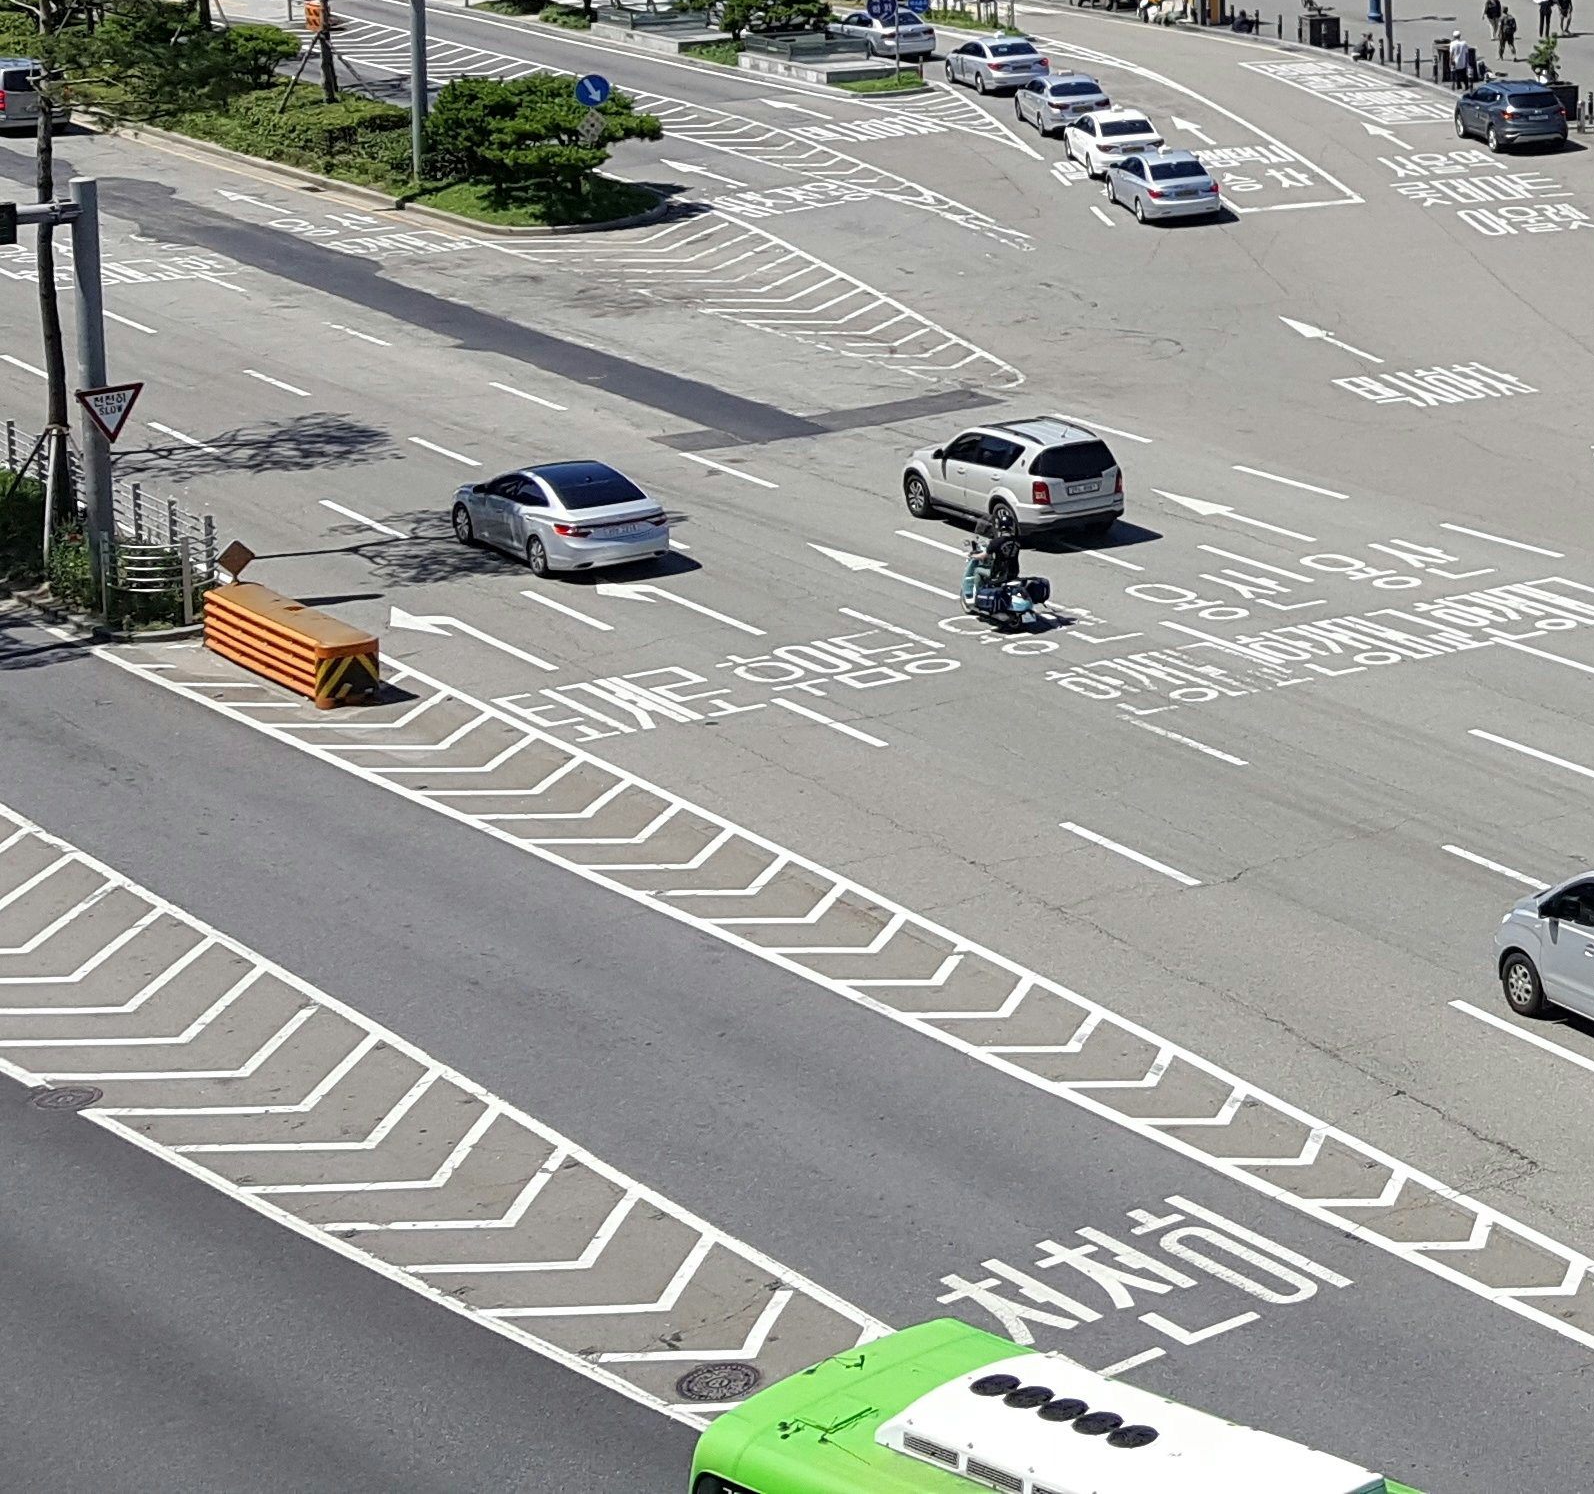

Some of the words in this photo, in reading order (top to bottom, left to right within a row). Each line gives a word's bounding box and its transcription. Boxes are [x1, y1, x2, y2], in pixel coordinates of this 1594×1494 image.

[1192, 145, 1297, 169] 범택시
[1377, 148, 1509, 177] 서울역
[1391, 172, 1575, 208] 롯데마트
[93, 392, 127, 408] 천천히
[1331, 361, 1540, 407] 택시하차
[99, 405, 123, 415] SLOW
[1300, 539, 1496, 590] 용산
[1126, 569, 1327, 620] 용산
[1236, 608, 1496, 678] 한강대교
[489, 666, 768, 742] 퇴계로
